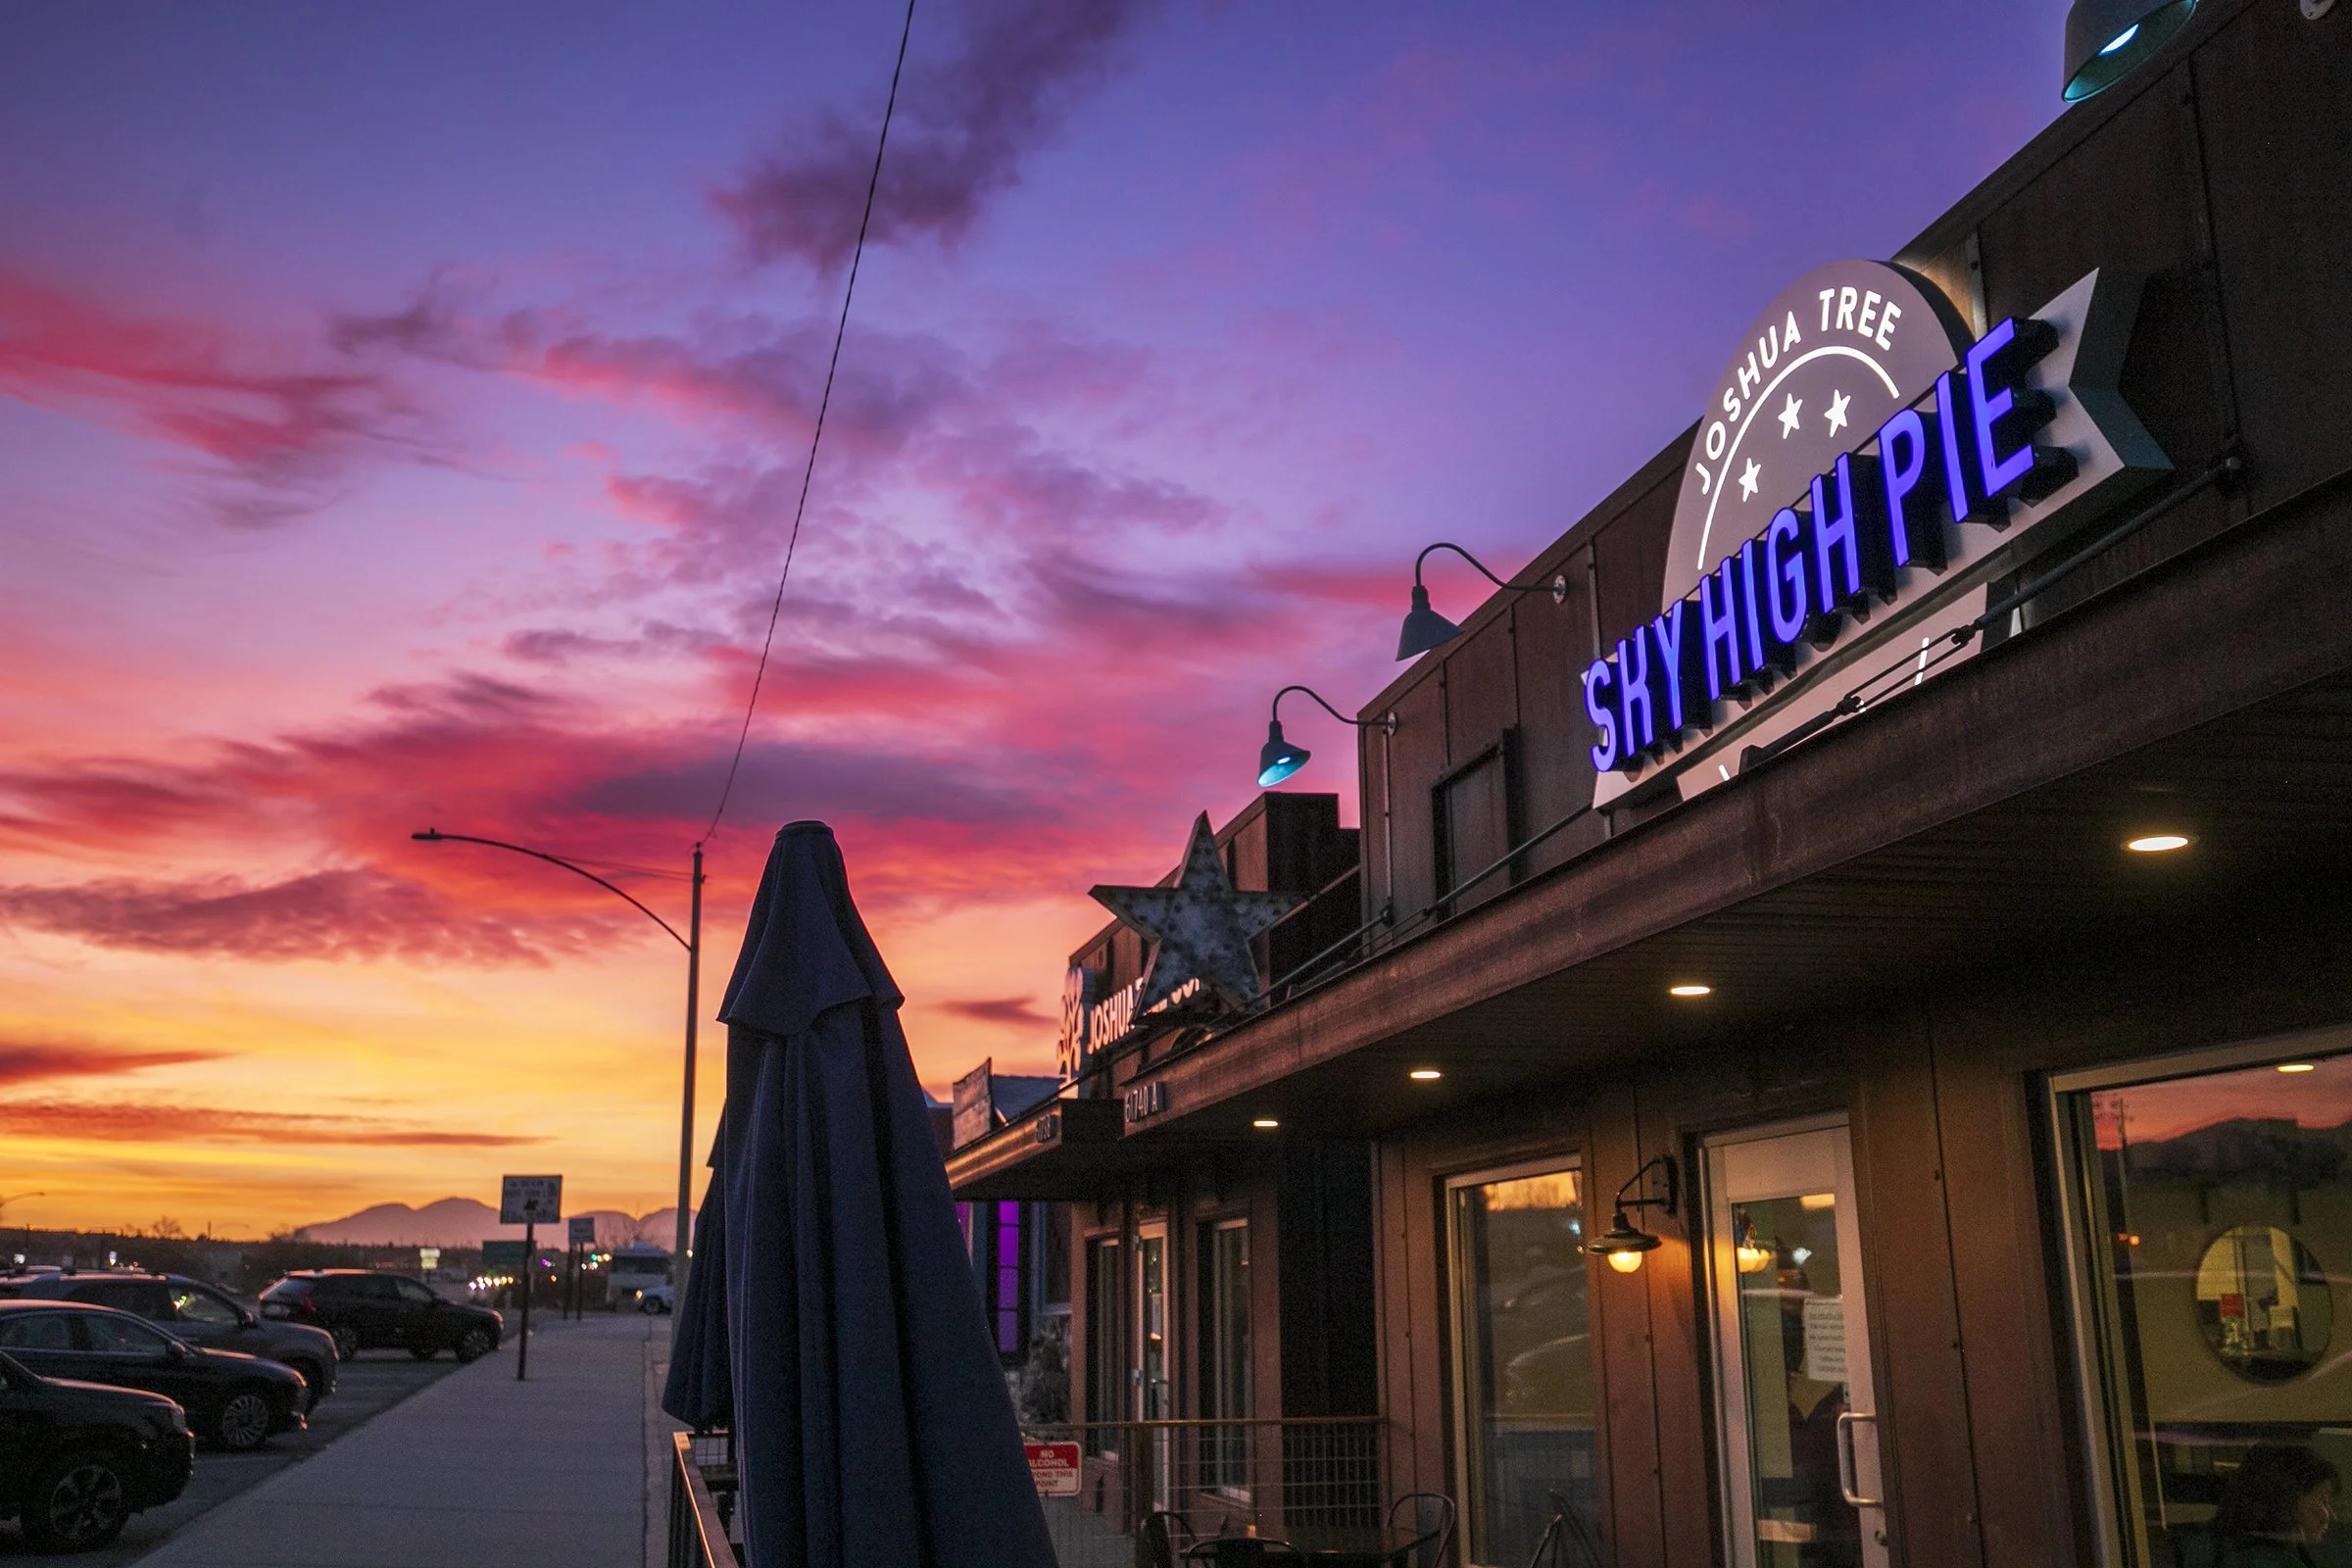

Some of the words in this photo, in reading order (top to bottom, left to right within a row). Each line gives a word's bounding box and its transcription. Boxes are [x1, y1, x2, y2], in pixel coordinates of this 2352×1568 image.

[1695, 311, 1802, 495] JOSHUA
[1819, 286, 1902, 352] TREE
[1585, 598, 1684, 773] SKY
[1699, 452, 1862, 702] HIGH
[1878, 317, 2035, 568] PIE
[1087, 984, 1135, 1055] JOSHUA
[1041, 1449, 1055, 1459] NO
